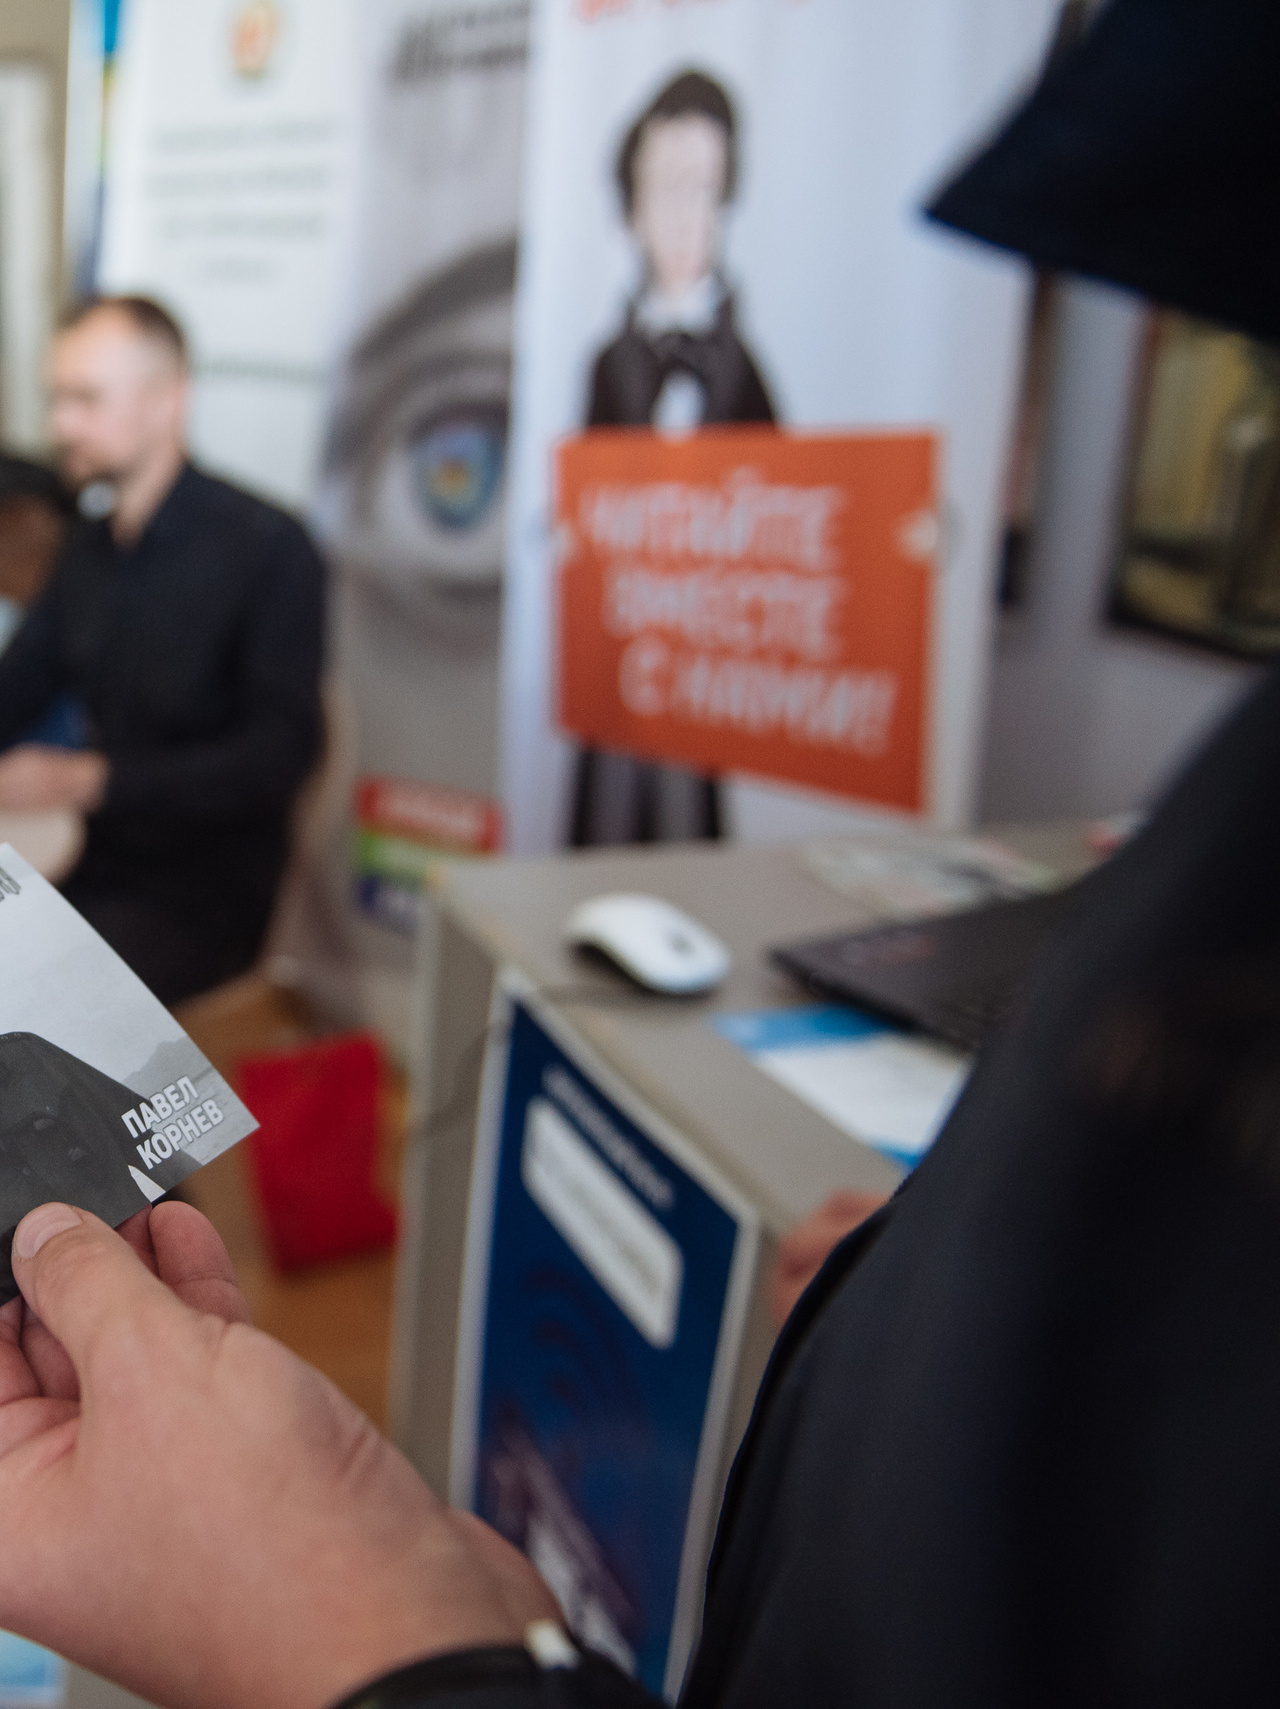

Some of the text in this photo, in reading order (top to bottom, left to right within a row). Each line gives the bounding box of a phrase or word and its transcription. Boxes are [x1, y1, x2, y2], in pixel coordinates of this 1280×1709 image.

[582, 468, 842, 568] ЧИТАЙТЕ
[605, 571, 845, 660] ВМЕСТЕ
[621, 638, 670, 716] С
[121, 1076, 199, 1138] ПАВЕЛ
[136, 1099, 224, 1170] КОРНЕВ
